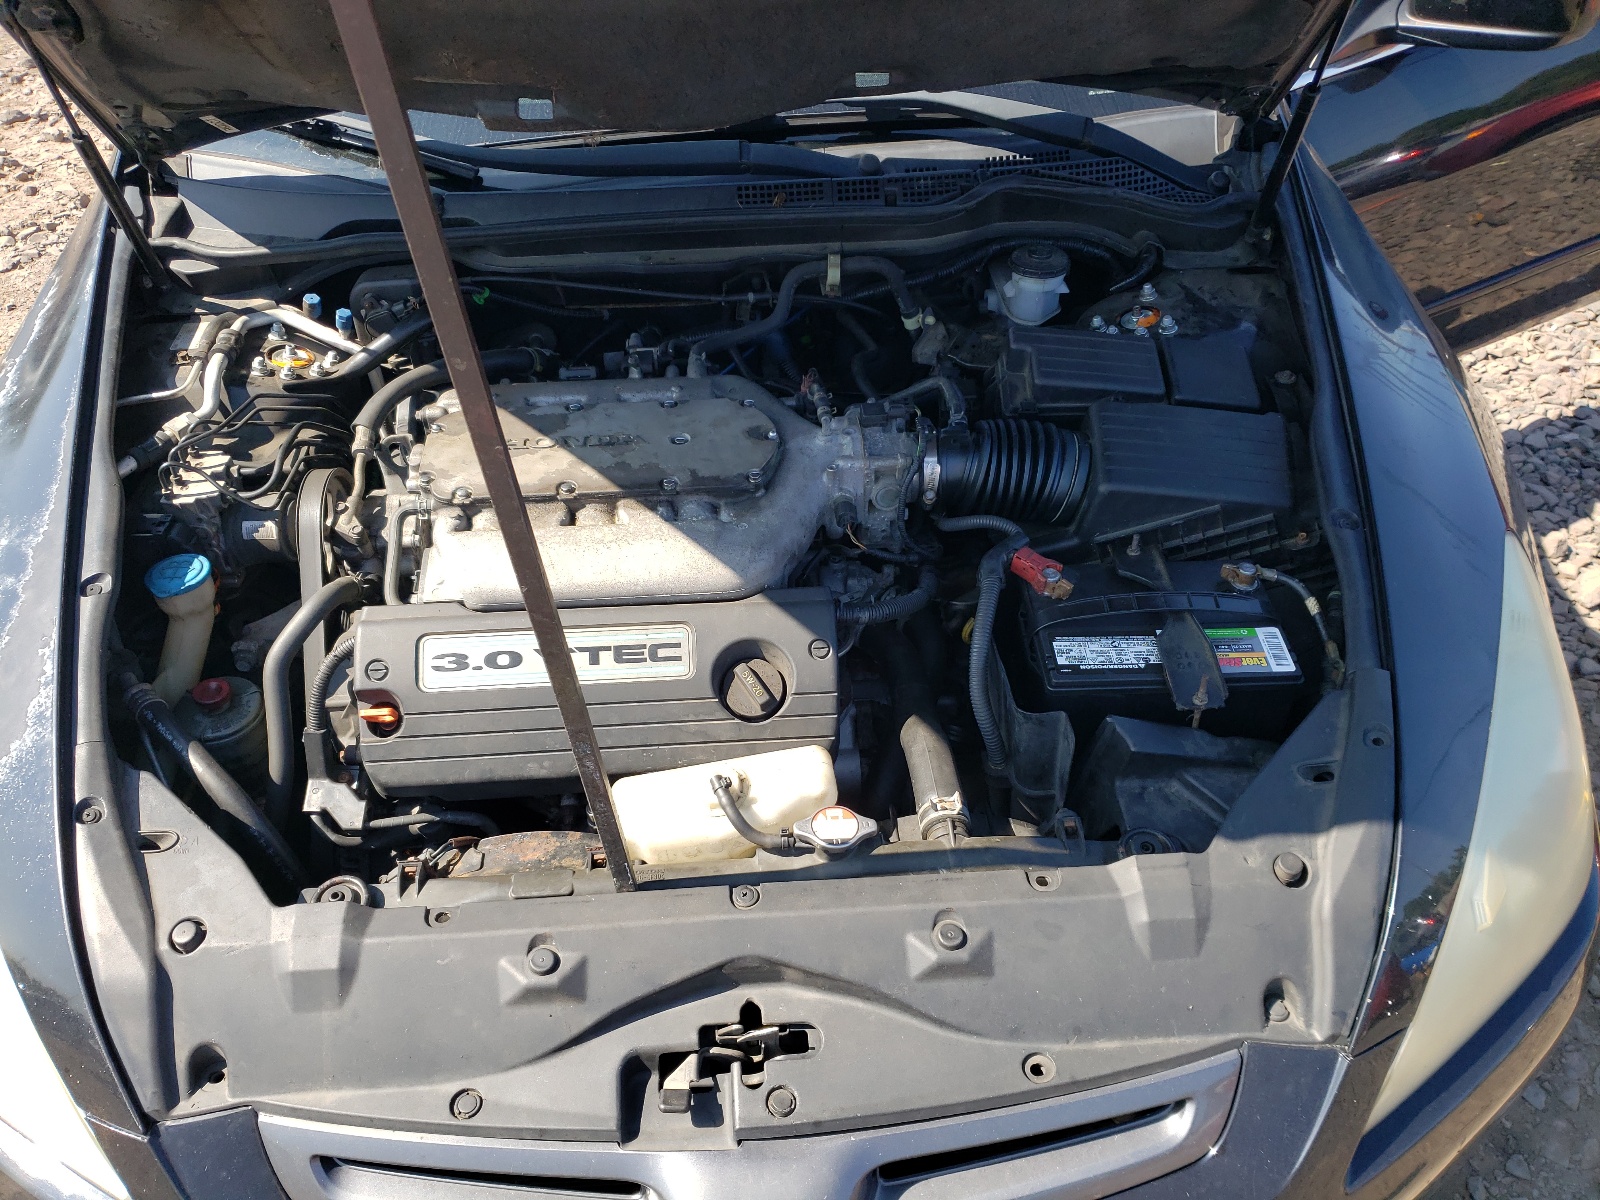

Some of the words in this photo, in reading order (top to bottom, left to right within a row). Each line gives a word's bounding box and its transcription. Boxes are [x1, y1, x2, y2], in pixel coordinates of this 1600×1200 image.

[431, 651, 523, 672] 3.0
[533, 643, 683, 665] TEC
[1217, 657, 1268, 667] EverStar
[742, 670, 763, 697] 5W-20
